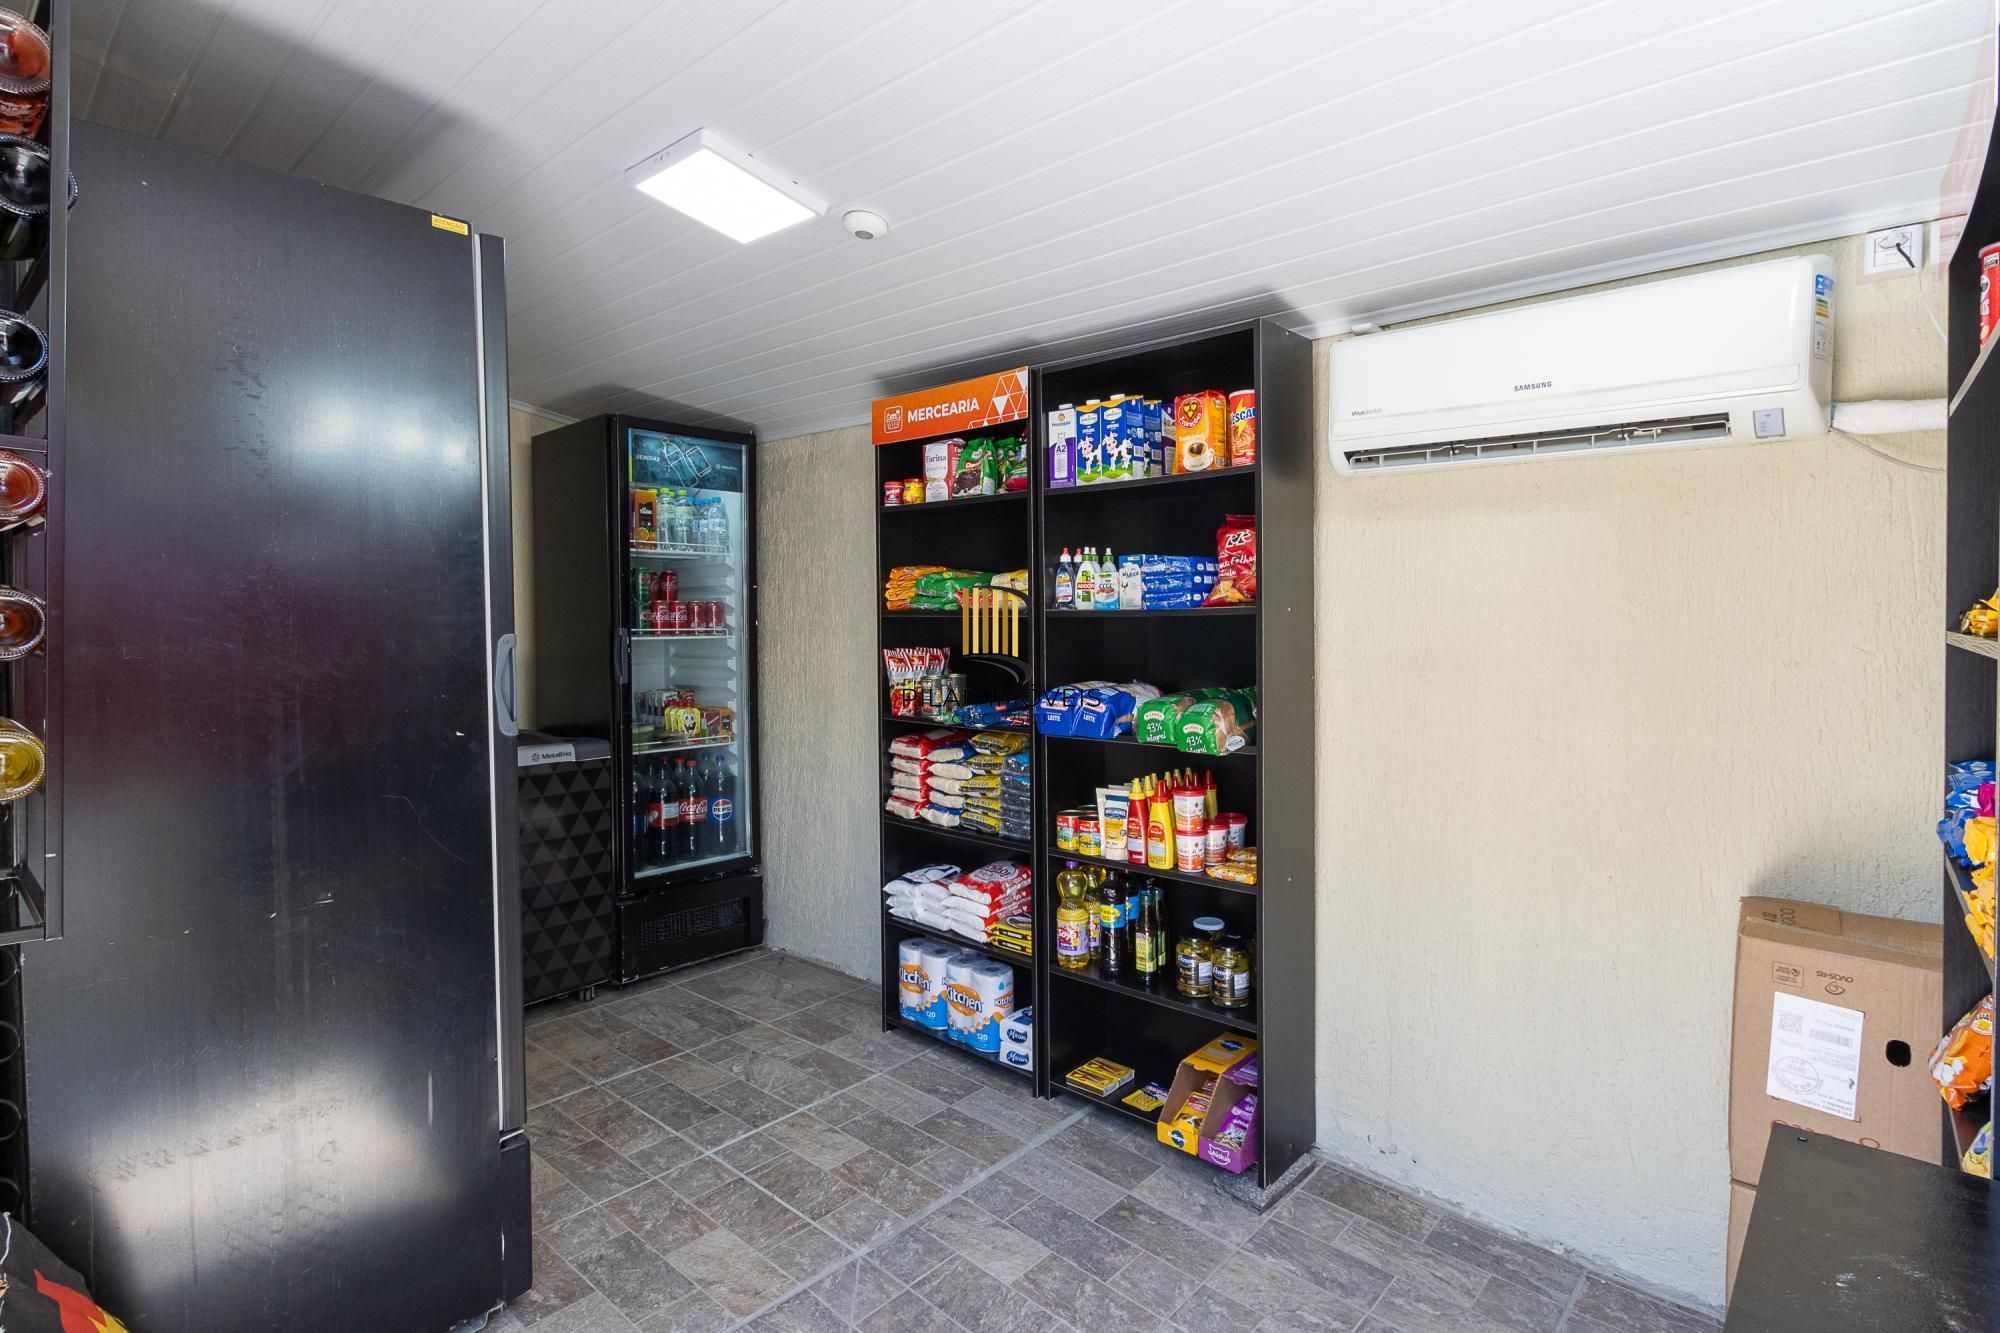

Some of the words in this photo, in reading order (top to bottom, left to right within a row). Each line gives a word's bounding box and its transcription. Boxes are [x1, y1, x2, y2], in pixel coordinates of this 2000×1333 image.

[1514, 381, 1552, 392] SAMSUNG
[907, 397, 980, 423] MERCEARIA
[1056, 444, 1067, 453] A2
[926, 455, 947, 464] Farina
[541, 751, 572, 760] Metalfrio
[977, 1033, 988, 1041] 120
